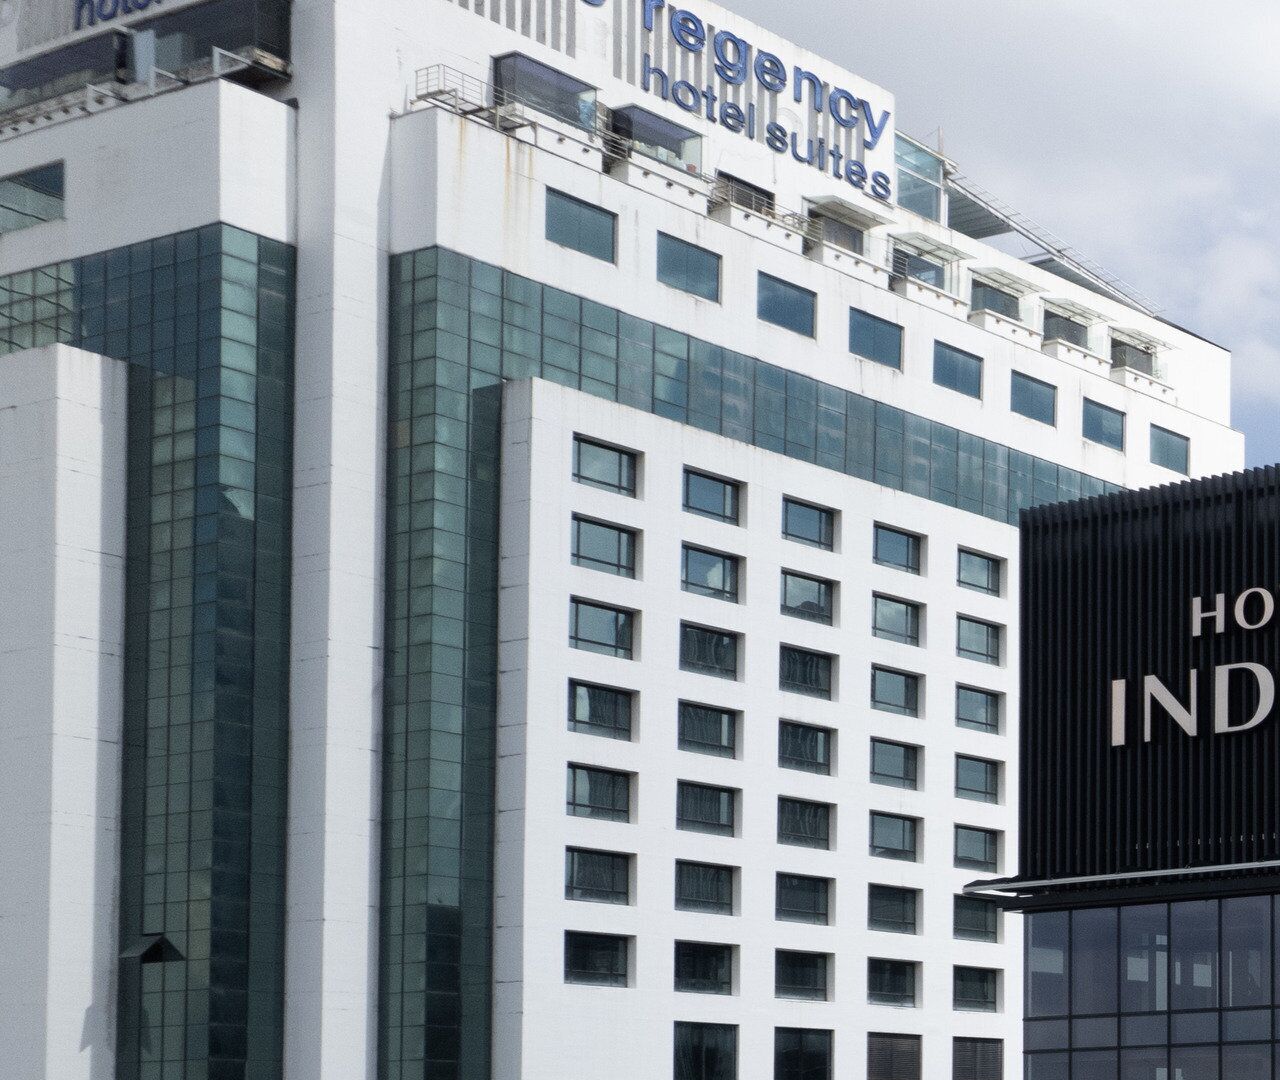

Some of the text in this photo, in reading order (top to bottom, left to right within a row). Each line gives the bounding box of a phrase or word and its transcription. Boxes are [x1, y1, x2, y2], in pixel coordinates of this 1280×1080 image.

[642, 0, 891, 150] regency
[642, 53, 892, 201] hotel suites
